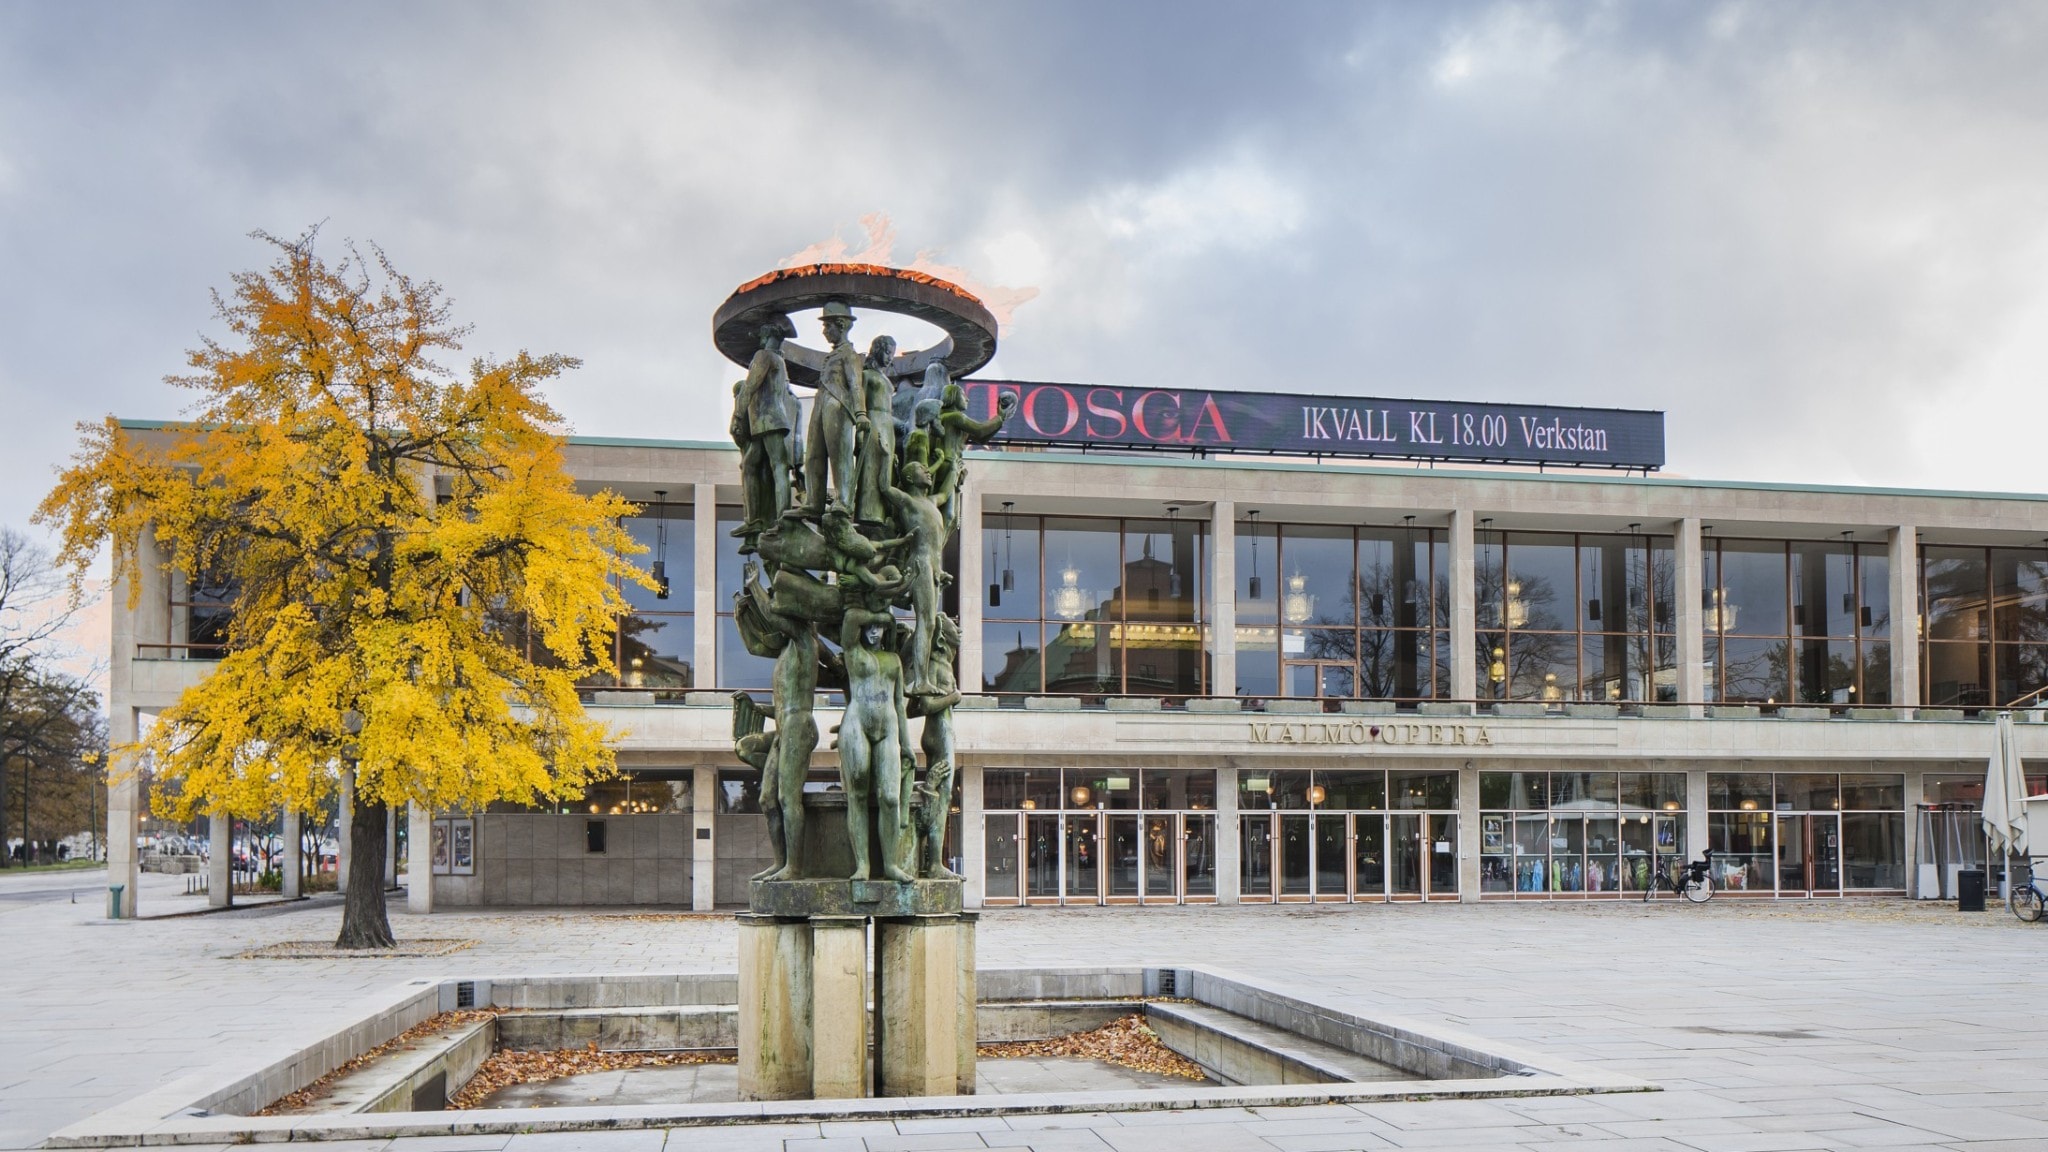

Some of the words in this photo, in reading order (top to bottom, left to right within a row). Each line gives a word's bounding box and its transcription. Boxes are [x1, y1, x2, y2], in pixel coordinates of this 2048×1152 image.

[965, 383, 1234, 442] TOSCA
[1302, 406, 1397, 442] IKVALL
[1409, 411, 1444, 444] KL
[1452, 413, 1507, 447] 18.00
[1519, 416, 1608, 451] Verkstan
[1249, 720, 1366, 744] MALMÖ
[1381, 723, 1494, 746] OPERA
